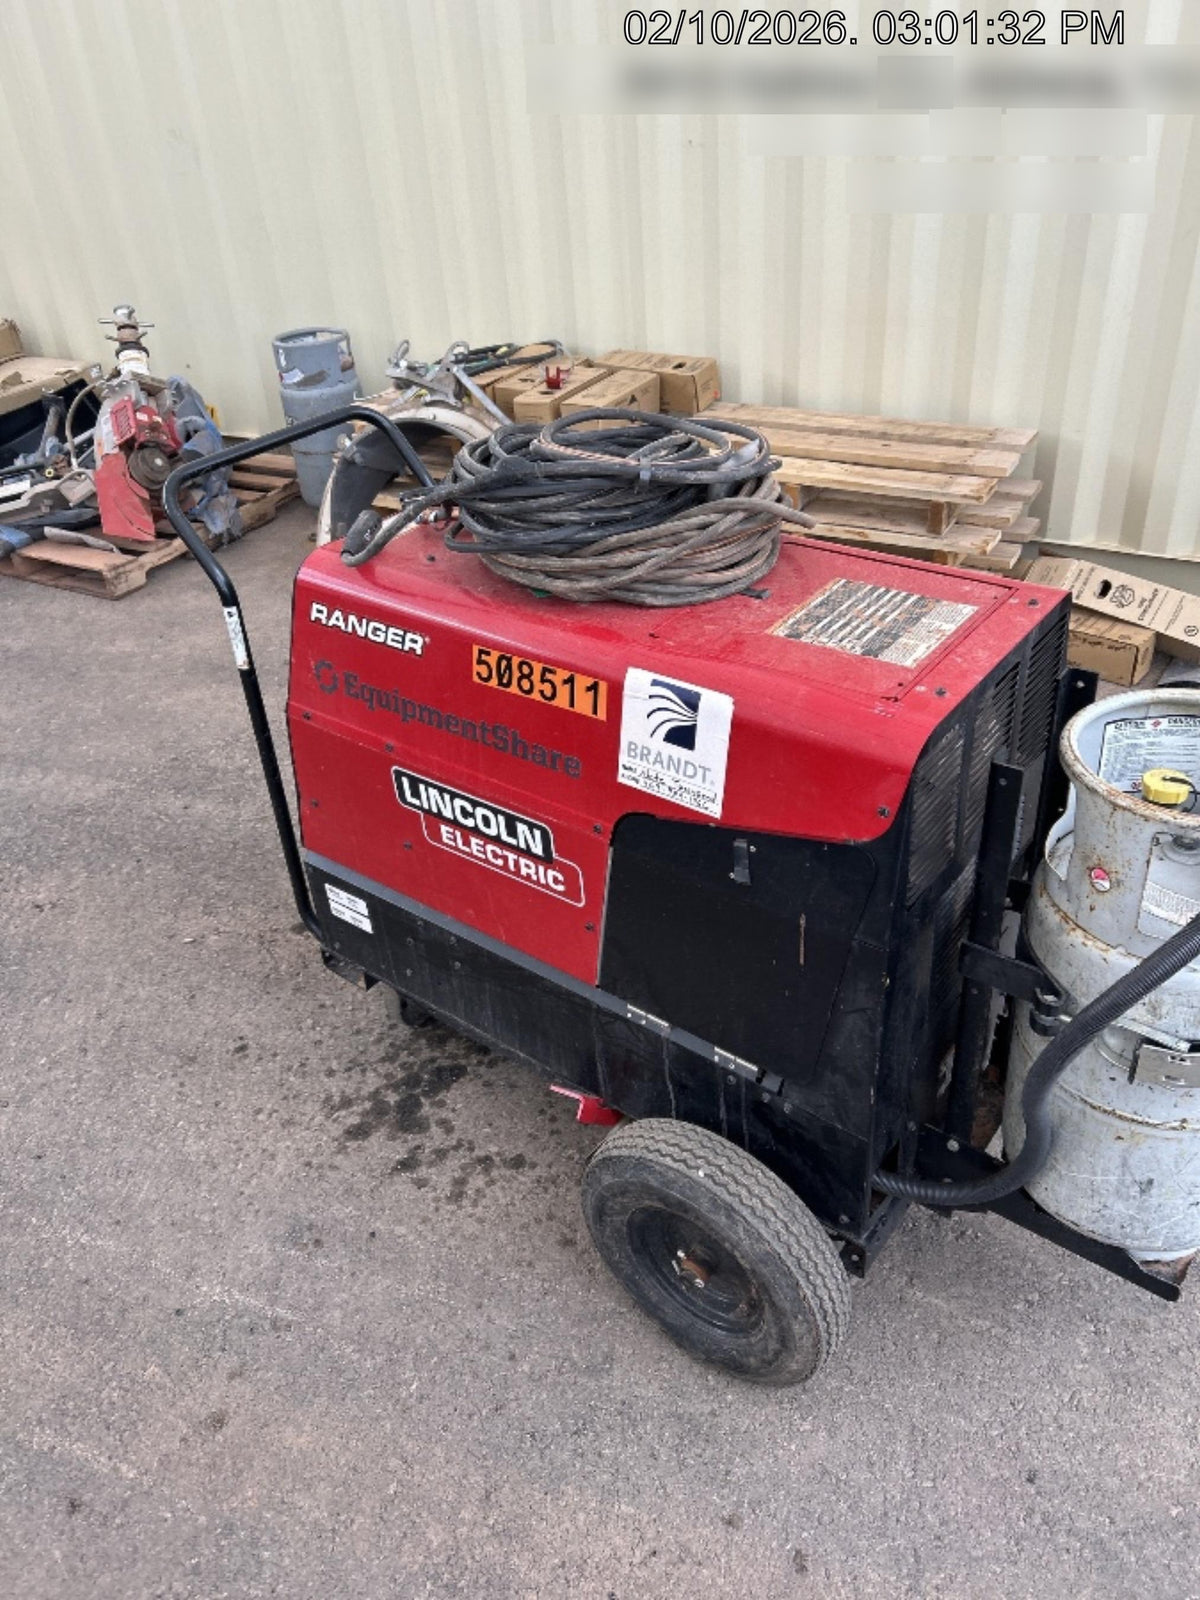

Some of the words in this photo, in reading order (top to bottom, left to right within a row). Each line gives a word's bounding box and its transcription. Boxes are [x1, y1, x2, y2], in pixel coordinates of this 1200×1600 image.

[475, 648, 600, 717] 508511
[344, 671, 582, 779] EquipmentShare
[401, 776, 545, 858] LINCOLN
[440, 824, 566, 892] ELECTRIC
